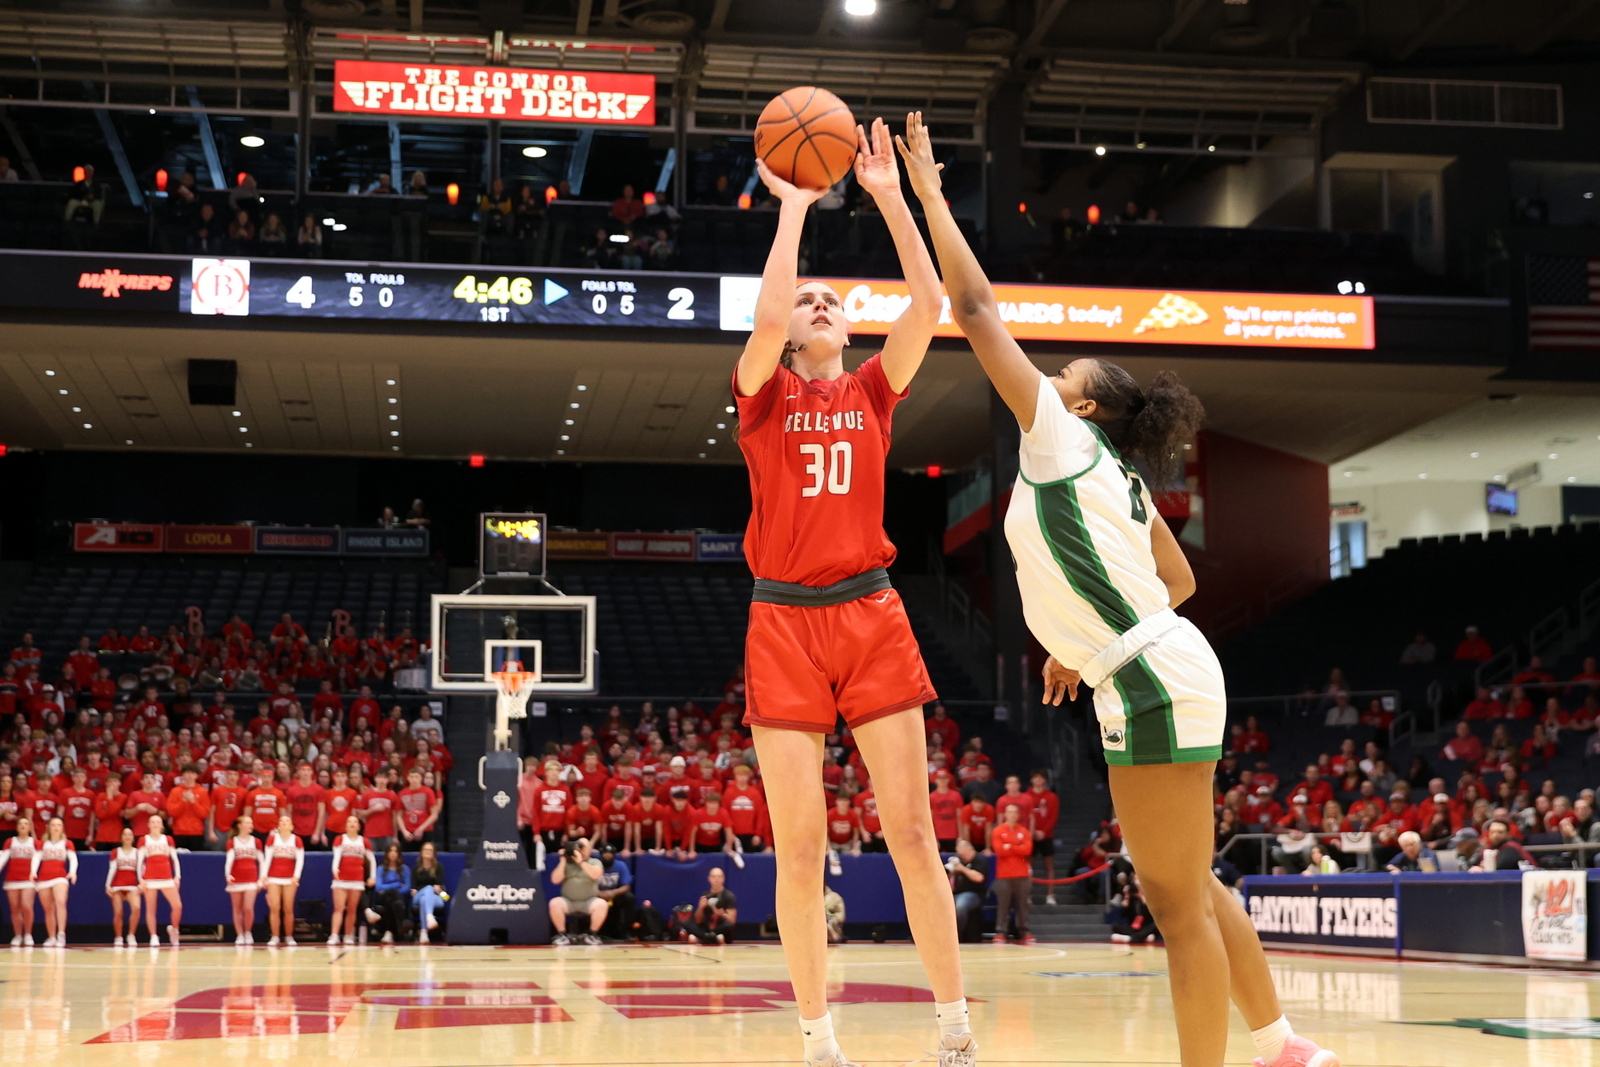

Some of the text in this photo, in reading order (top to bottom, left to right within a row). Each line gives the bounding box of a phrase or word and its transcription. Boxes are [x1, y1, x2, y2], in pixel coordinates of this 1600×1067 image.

[404, 67, 588, 92] THE CONNOR
[363, 80, 626, 120] FLIGHT DECK
[213, 274, 233, 297] B
[345, 272, 405, 286] TOL FOULS
[453, 275, 533, 305] 4:46
[581, 280, 637, 294] FOULS TOL
[286, 275, 316, 309] 4
[347, 286, 394, 308] 5 0
[480, 306, 510, 322] 1ST
[592, 294, 635, 316] 0 5
[666, 287, 696, 321] 2
[1222, 305, 1358, 325] You'll earn points on
[1067, 304, 1123, 329] today!
[1223, 321, 1242, 336] all
[1242, 324, 1275, 340] your
[784, 410, 865, 434] BELLEVUE
[798, 441, 853, 498] 30
[184, 532, 233, 546] LOYOLA
[701, 541, 737, 553] SAINT
[483, 840, 519, 850] Premier
[466, 884, 536, 904] altafiber
[1249, 896, 1398, 938] DAYTON FLYERS
